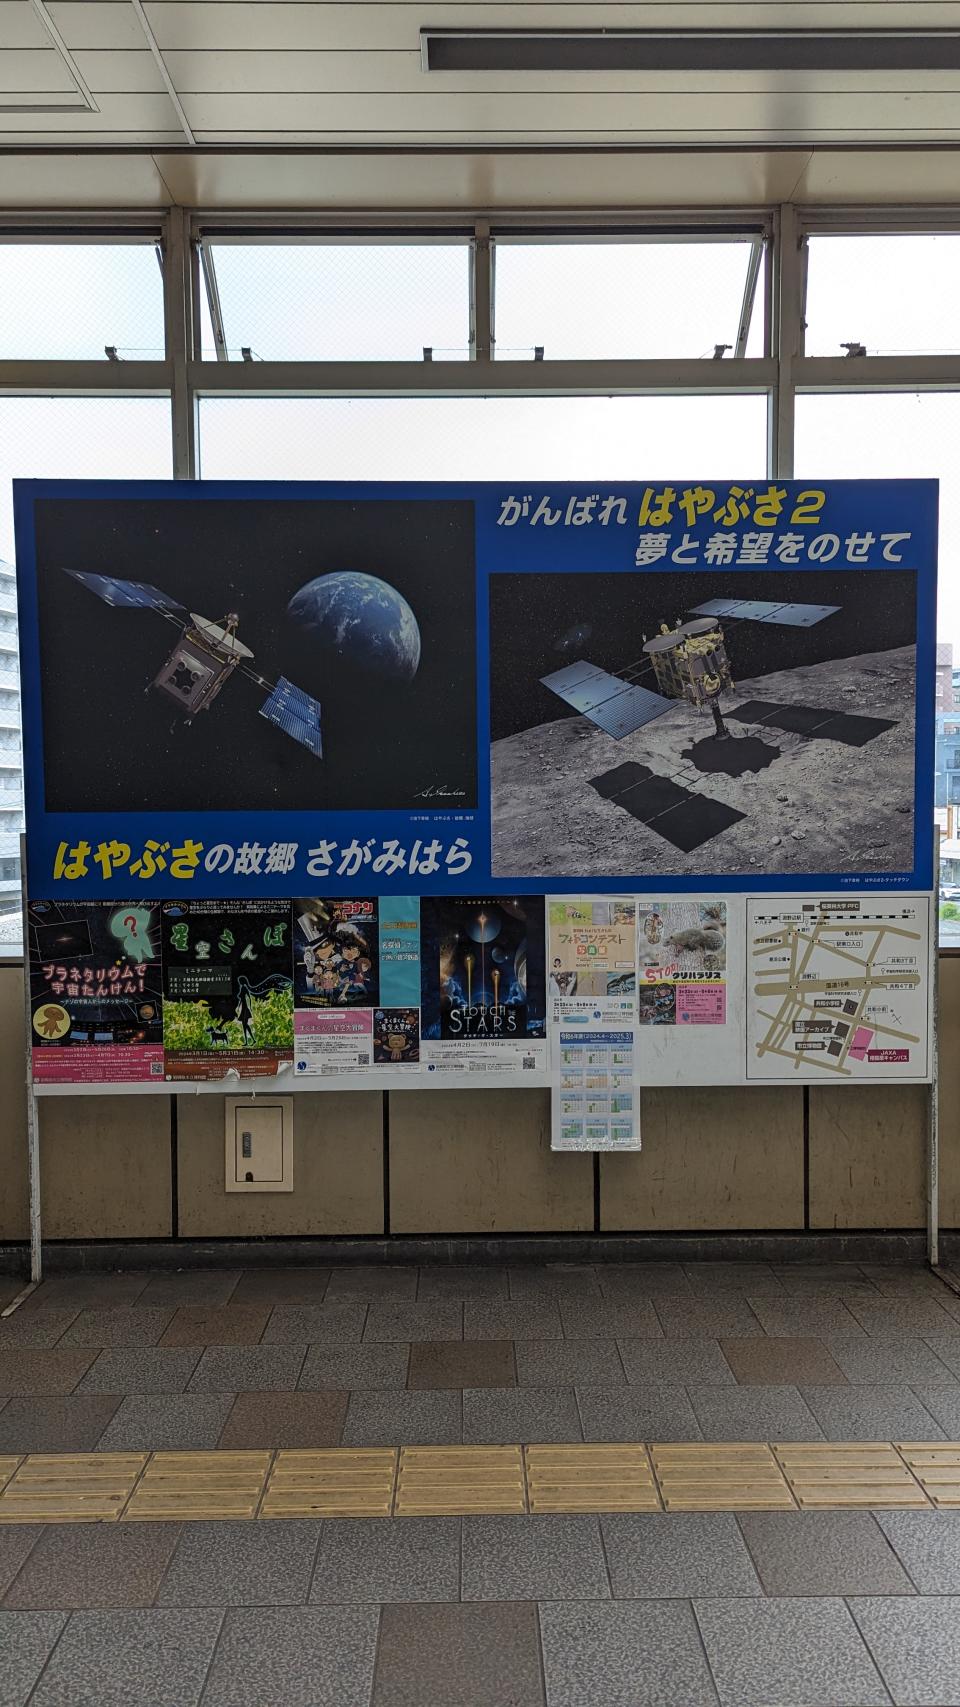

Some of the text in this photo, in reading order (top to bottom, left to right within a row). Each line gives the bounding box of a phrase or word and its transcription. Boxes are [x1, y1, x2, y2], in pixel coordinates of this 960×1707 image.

[496, 486, 827, 528] がんばれ はやぶさ2
[635, 532, 912, 567] 夢と希望をのせて
[52, 838, 473, 881] はやぶさの故郷 さがみはら
[342, 901, 374, 915] コナン
[170, 922, 288, 961] 星空さんぽ
[558, 933, 627, 945] フォトコンテスト
[42, 963, 147, 983] プラネタリウムで
[672, 971, 722, 979] クリハラリス
[51, 978, 145, 996] 宇宙たんけん！
[449, 1009, 517, 1033] STARS
[461, 1005, 506, 1017] TOUCH
